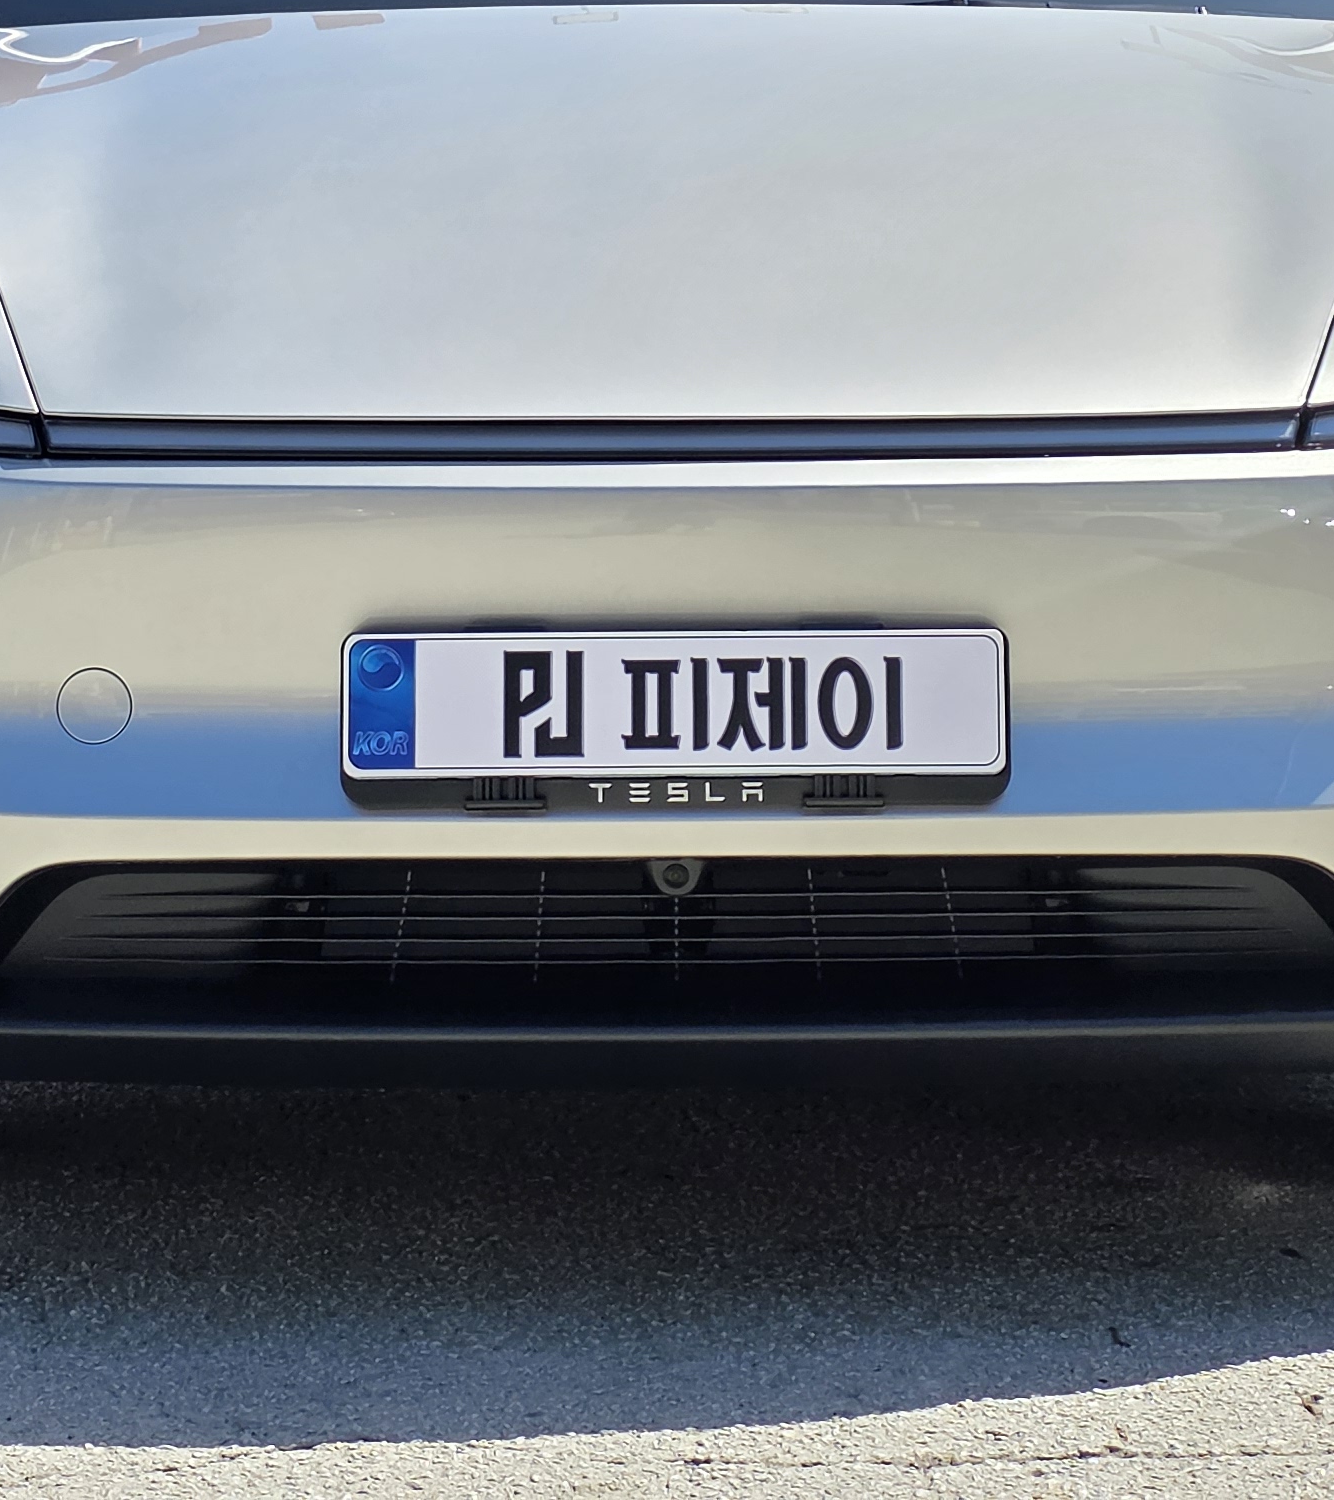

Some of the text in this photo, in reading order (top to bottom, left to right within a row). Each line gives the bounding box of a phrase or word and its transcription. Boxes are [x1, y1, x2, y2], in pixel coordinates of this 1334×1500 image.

[503, 649, 905, 759] PJ 피제이
[352, 730, 410, 756] KOR
[588, 781, 765, 804] TESLA
